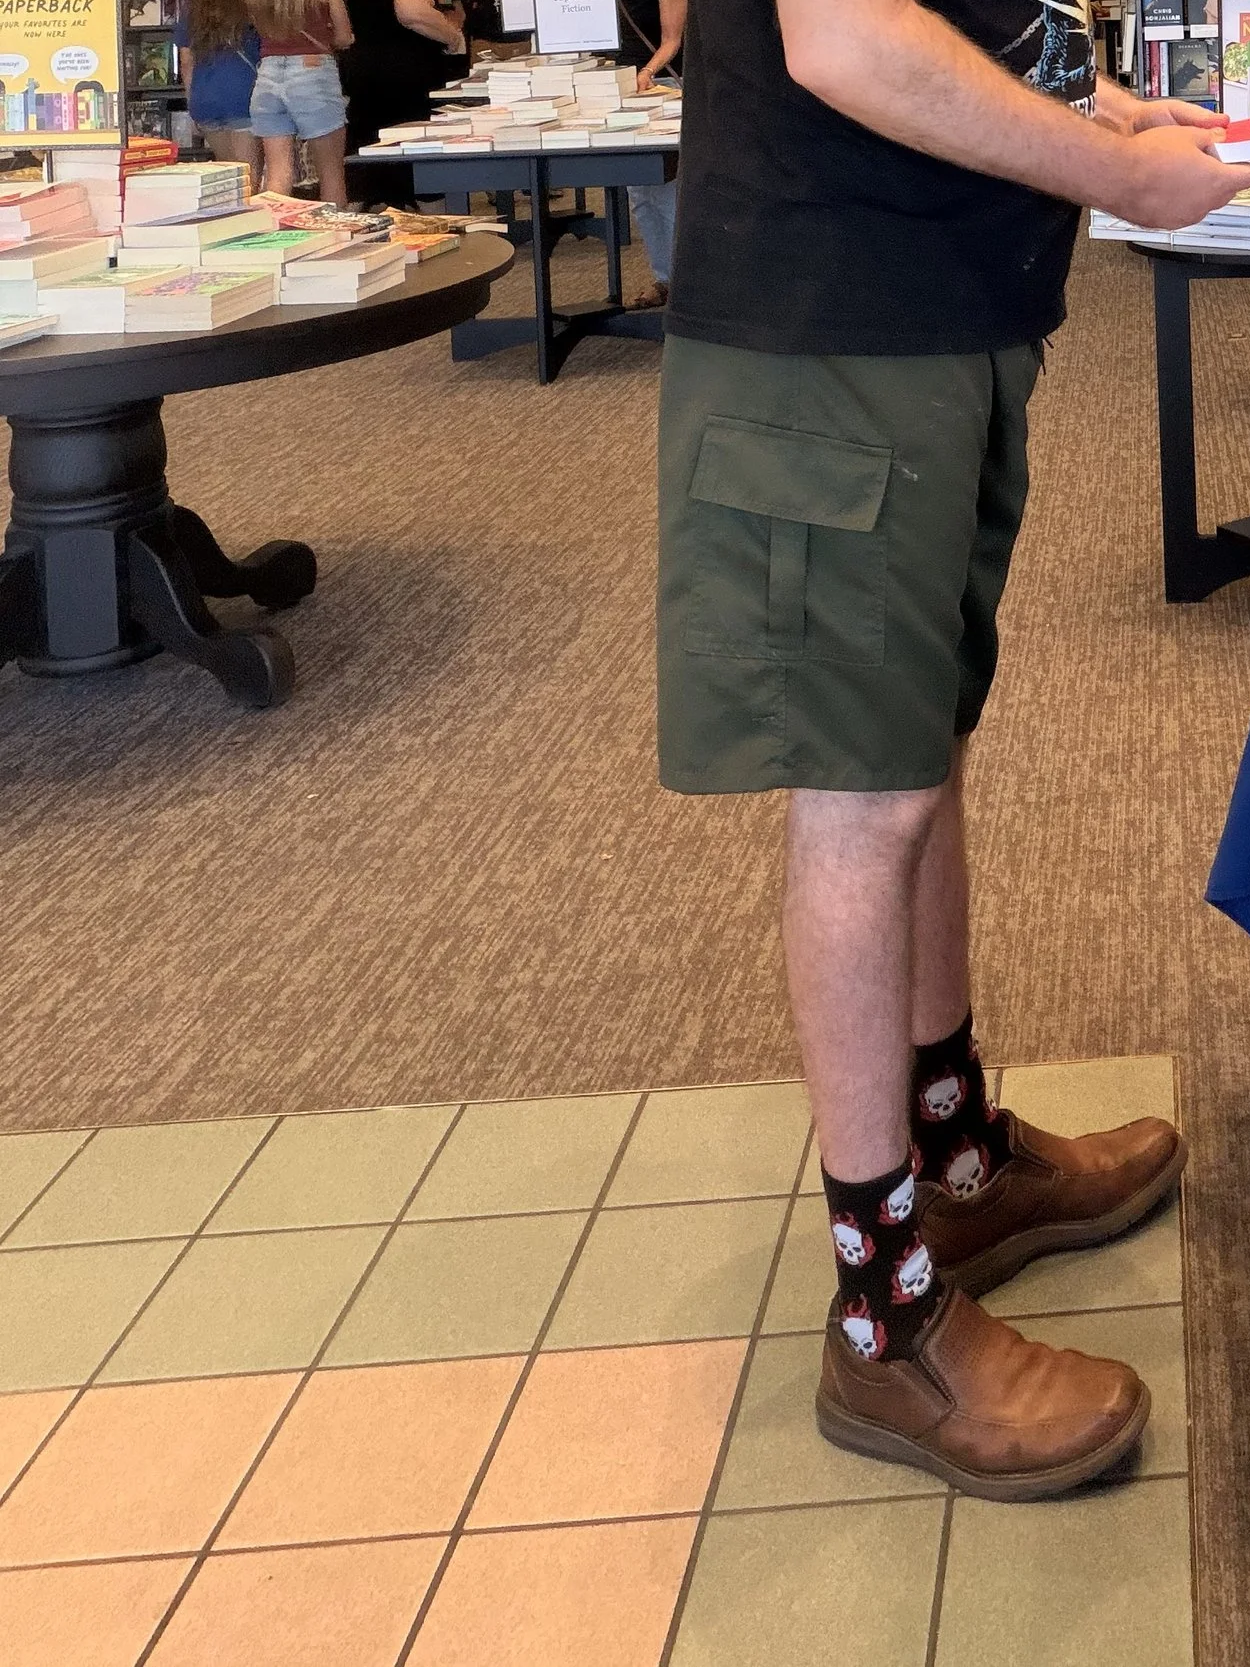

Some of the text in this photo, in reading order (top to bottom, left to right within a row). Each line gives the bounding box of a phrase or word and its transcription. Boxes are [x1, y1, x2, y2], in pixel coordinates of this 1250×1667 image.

[561, 3, 592, 14] Fiction
[24, 19, 67, 28] FAVORITES
[71, 19, 87, 27] ARE
